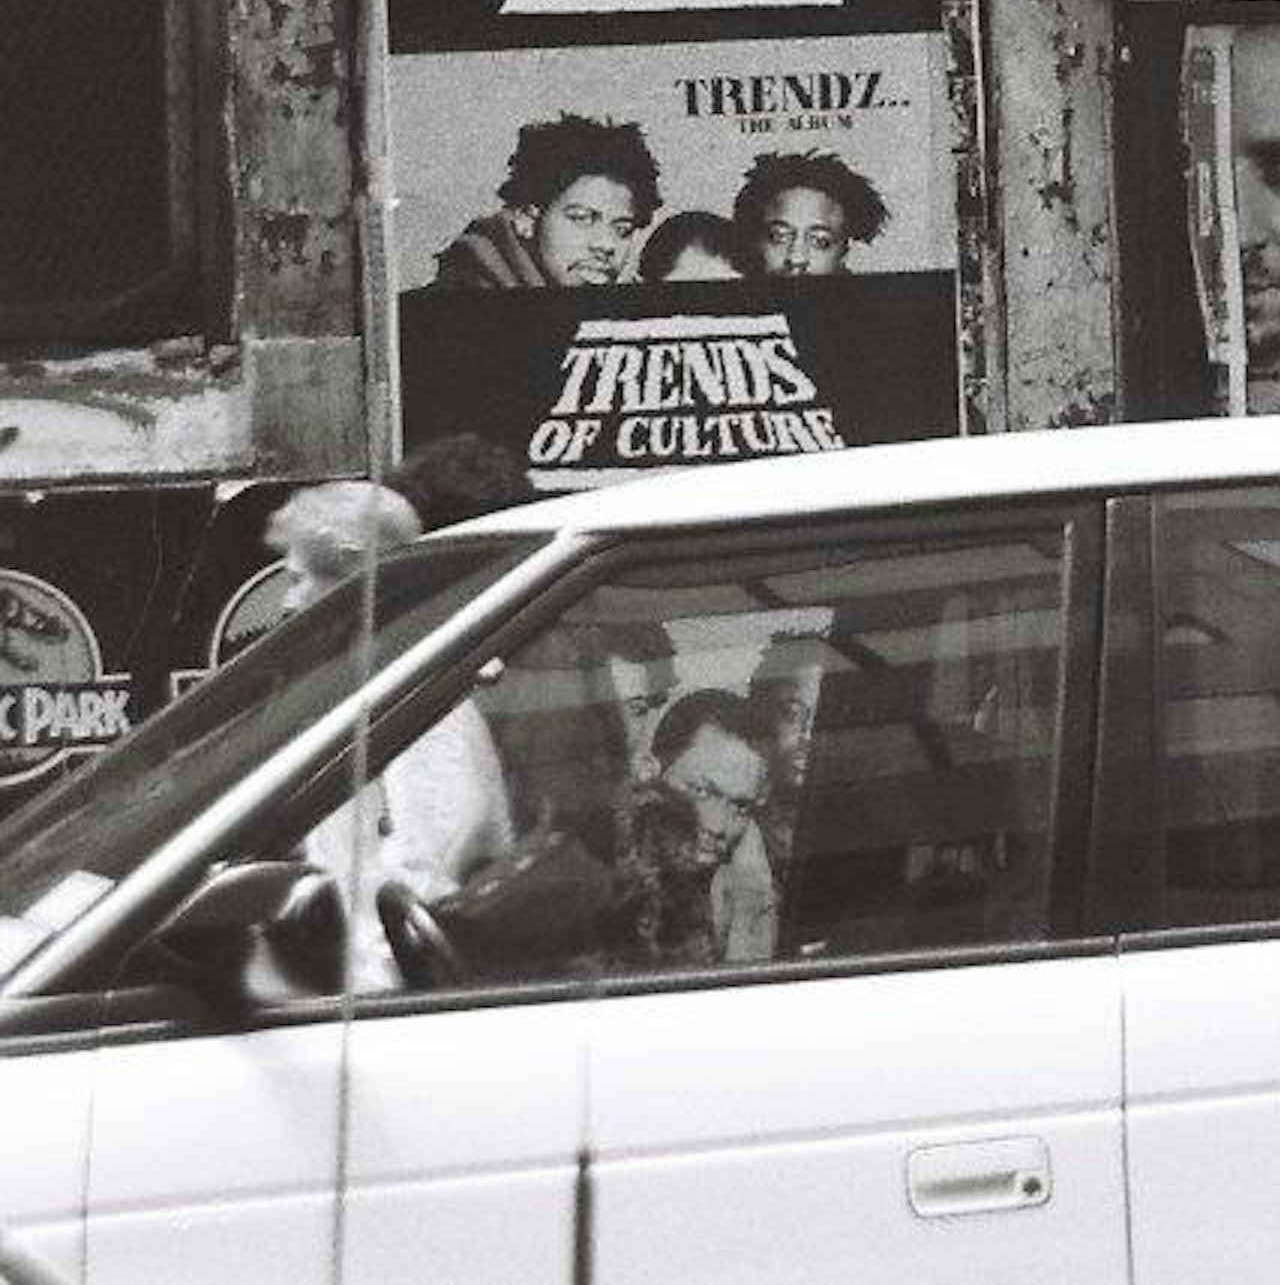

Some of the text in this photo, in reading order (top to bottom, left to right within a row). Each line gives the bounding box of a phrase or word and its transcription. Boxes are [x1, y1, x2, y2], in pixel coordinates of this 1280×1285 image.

[550, 336, 817, 415] TRENDS
[528, 407, 846, 463] OF CULTURE
[25, 687, 131, 744] PARK
